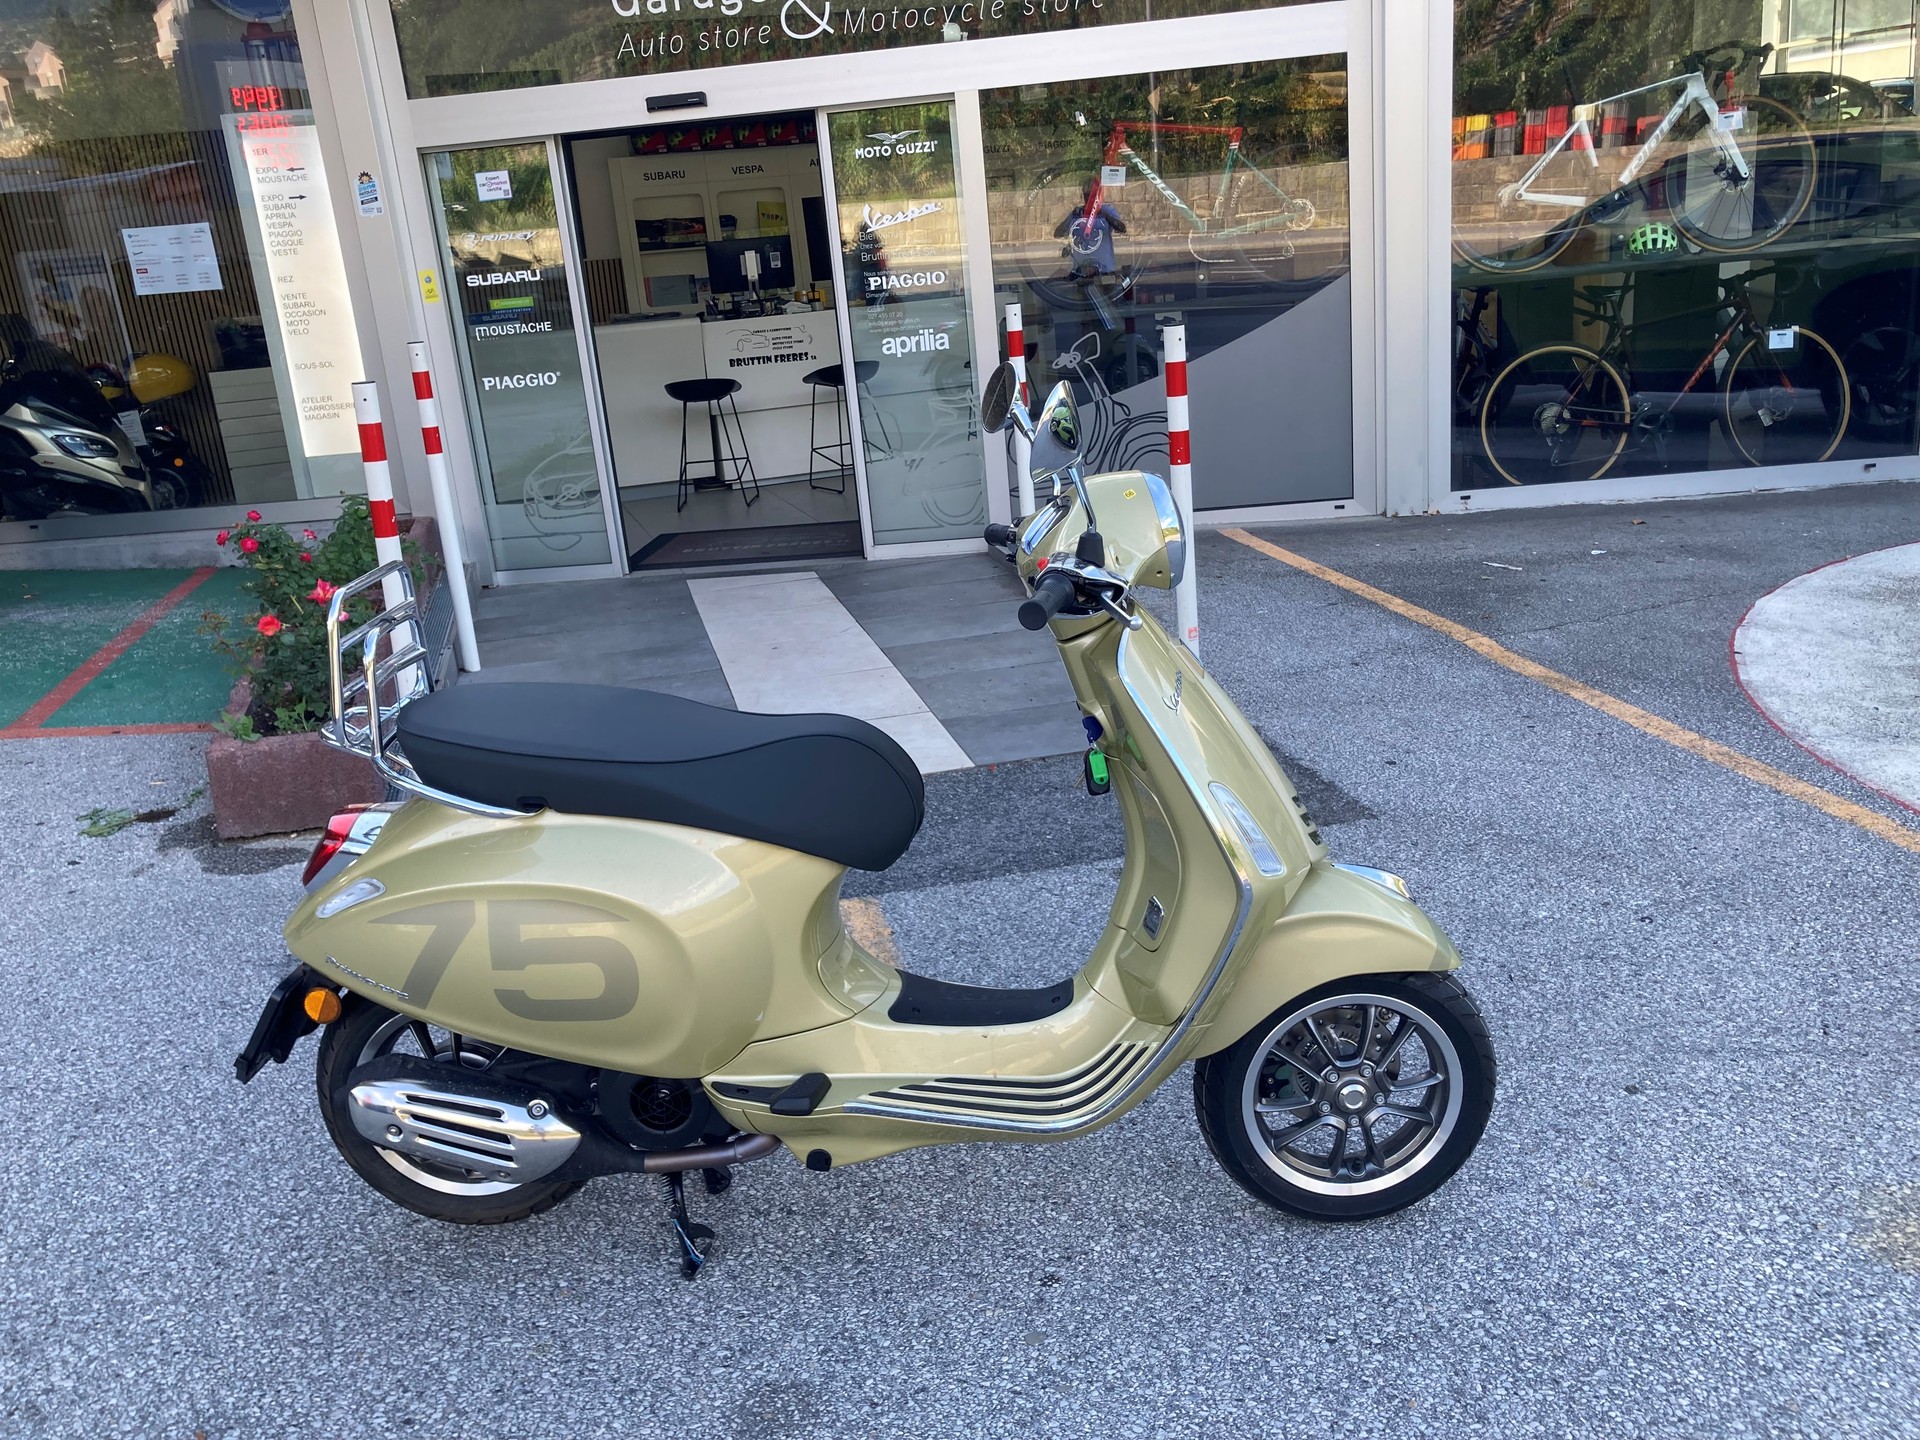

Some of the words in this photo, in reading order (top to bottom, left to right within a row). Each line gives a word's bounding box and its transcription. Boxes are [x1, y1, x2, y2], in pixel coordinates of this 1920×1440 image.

[843, 0, 1004, 35] Motocycle
[617, 33, 684, 60] Auto
[698, 25, 771, 51] store
[855, 144, 892, 160] MOTO
[895, 141, 935, 156] GUZZI
[255, 166, 279, 175] EXPO
[731, 164, 765, 175] VESPA
[257, 173, 309, 184] MOUSTACHE
[643, 170, 686, 182] SUBARU
[1131, 157, 1188, 208] RIDLEY
[261, 193, 285, 203] EXPO
[263, 202, 297, 212] SUBARU
[265, 211, 297, 221] APRILIA
[864, 203, 943, 233] Vespa
[267, 220, 294, 230] VESPA
[268, 229, 303, 239] PIAGGIO
[480, 230, 539, 243] RIDLEY
[270, 238, 304, 248] CASQUE
[272, 247, 299, 256] VESTE
[277, 275, 295, 283] REZ
[466, 269, 541, 287] SUBARU
[868, 271, 945, 291] PIAGGIO
[281, 292, 308, 301] VENTE
[282, 300, 316, 310] SUBARU
[284, 308, 327, 319] OCCASION
[286, 318, 310, 328] MOTO
[288, 327, 309, 336] VELO
[881, 329, 950, 358] aprilia
[729, 355, 773, 368] BRUTTIN
[774, 352, 809, 364] FRERES
[294, 361, 335, 371] SOUS-SOL
[482, 372, 557, 391] PIAGGIO
[301, 395, 333, 405] ATELIER
[303, 402, 355, 413] CARROSSERI
[304, 412, 340, 422] MAGASIN
[367, 900, 640, 1022] 75
